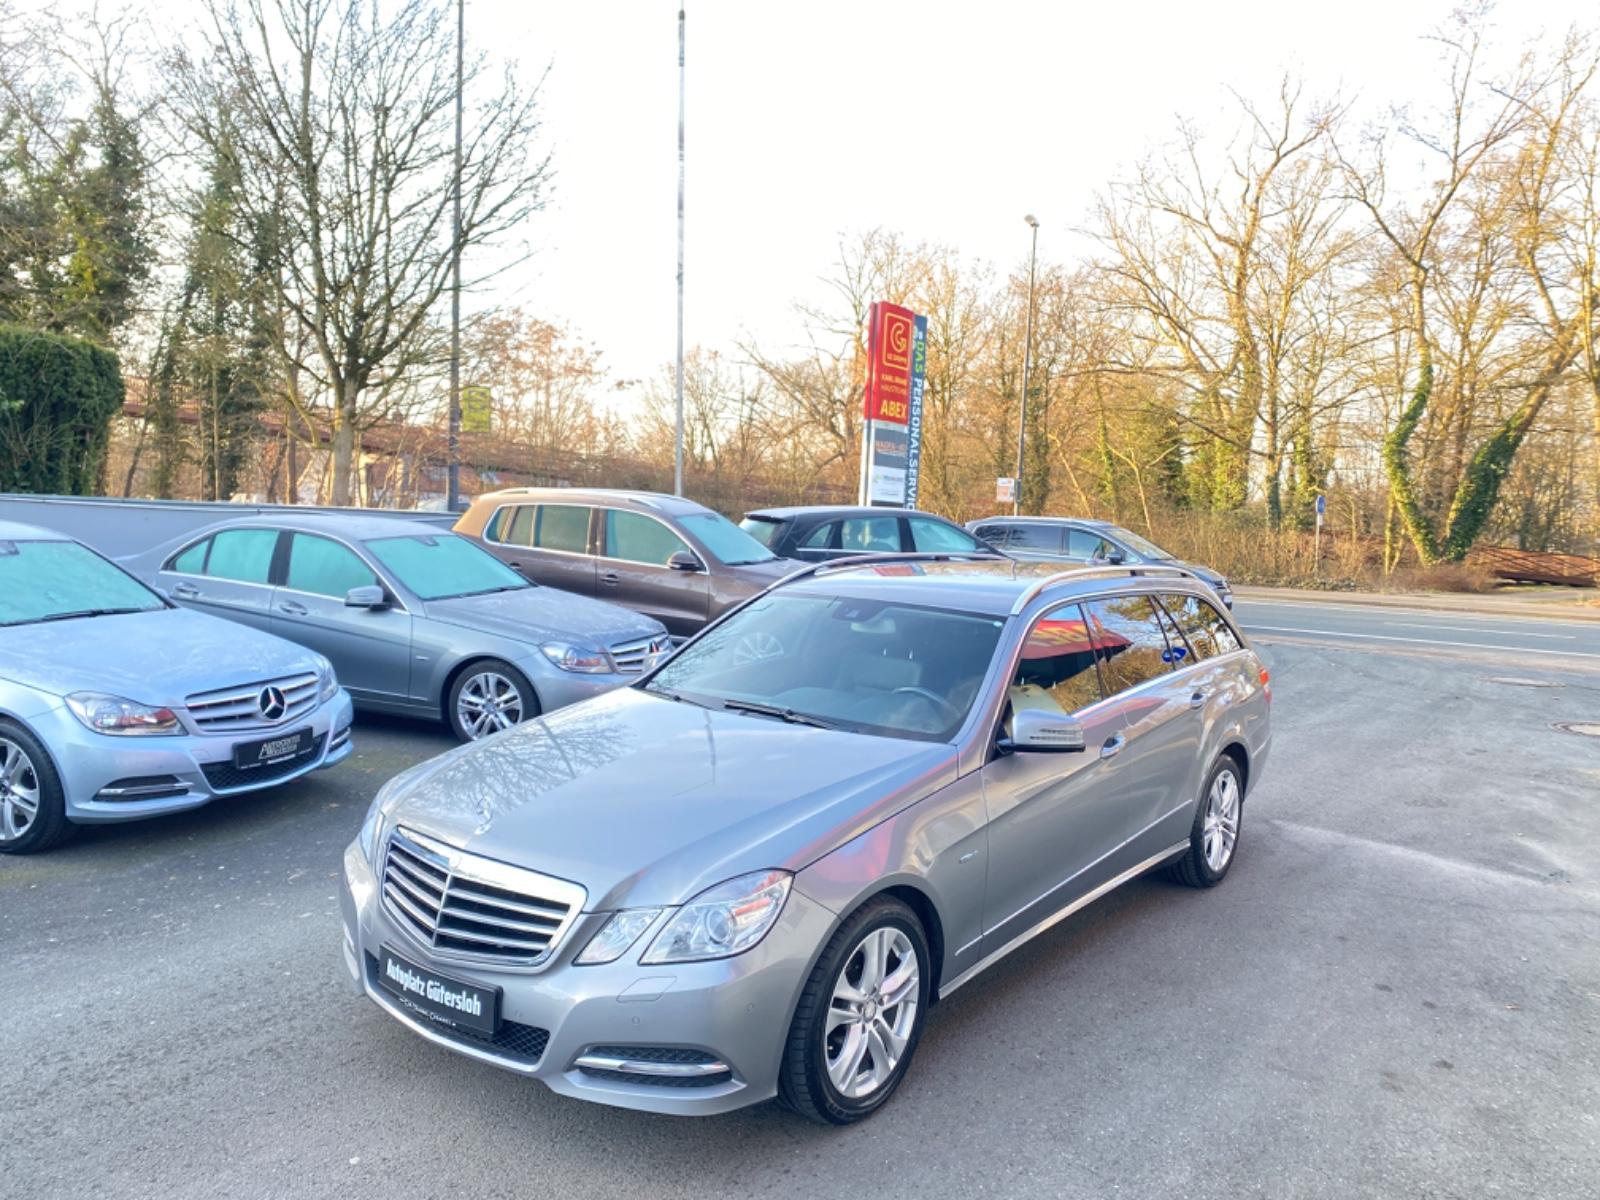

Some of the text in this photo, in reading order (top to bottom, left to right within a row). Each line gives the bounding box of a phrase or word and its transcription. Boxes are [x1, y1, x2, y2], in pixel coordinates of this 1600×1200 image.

[905, 340, 925, 511] DAS PERSONALSERVIC
[386, 958, 425, 996] Autoplatz
[426, 979, 482, 1017] Gütersloh
